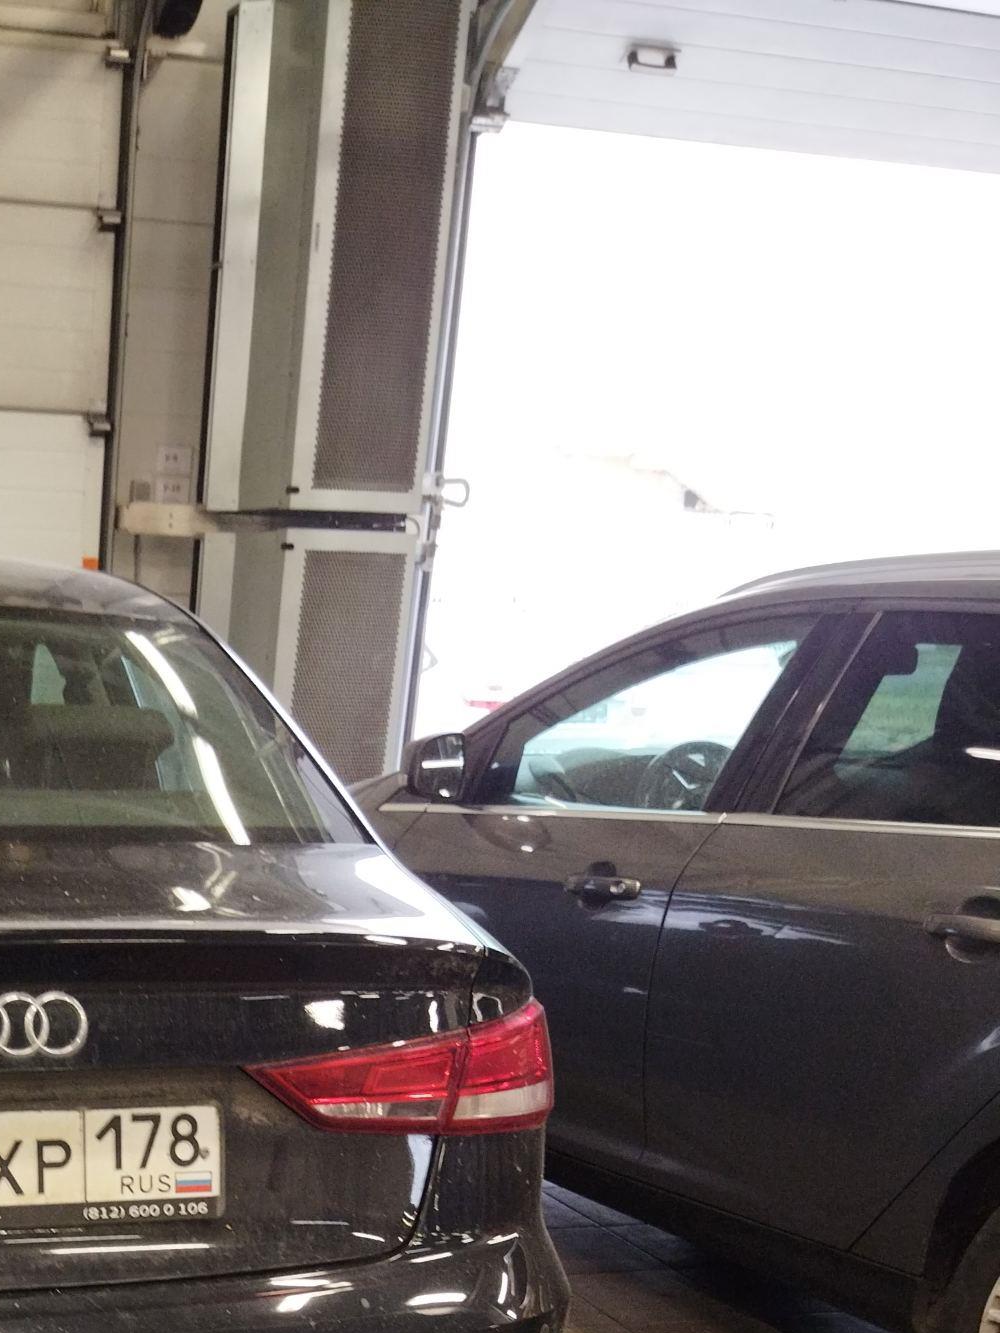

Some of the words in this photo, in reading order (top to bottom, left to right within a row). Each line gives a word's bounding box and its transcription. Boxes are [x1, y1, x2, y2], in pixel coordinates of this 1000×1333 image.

[95, 1112, 200, 1170] 178
[120, 1173, 172, 1195] RUS
[83, 1205, 126, 1221] (812)
[128, 1204, 160, 1218] 600
[163, 1203, 175, 1216] 0
[178, 1201, 209, 1216] 106
